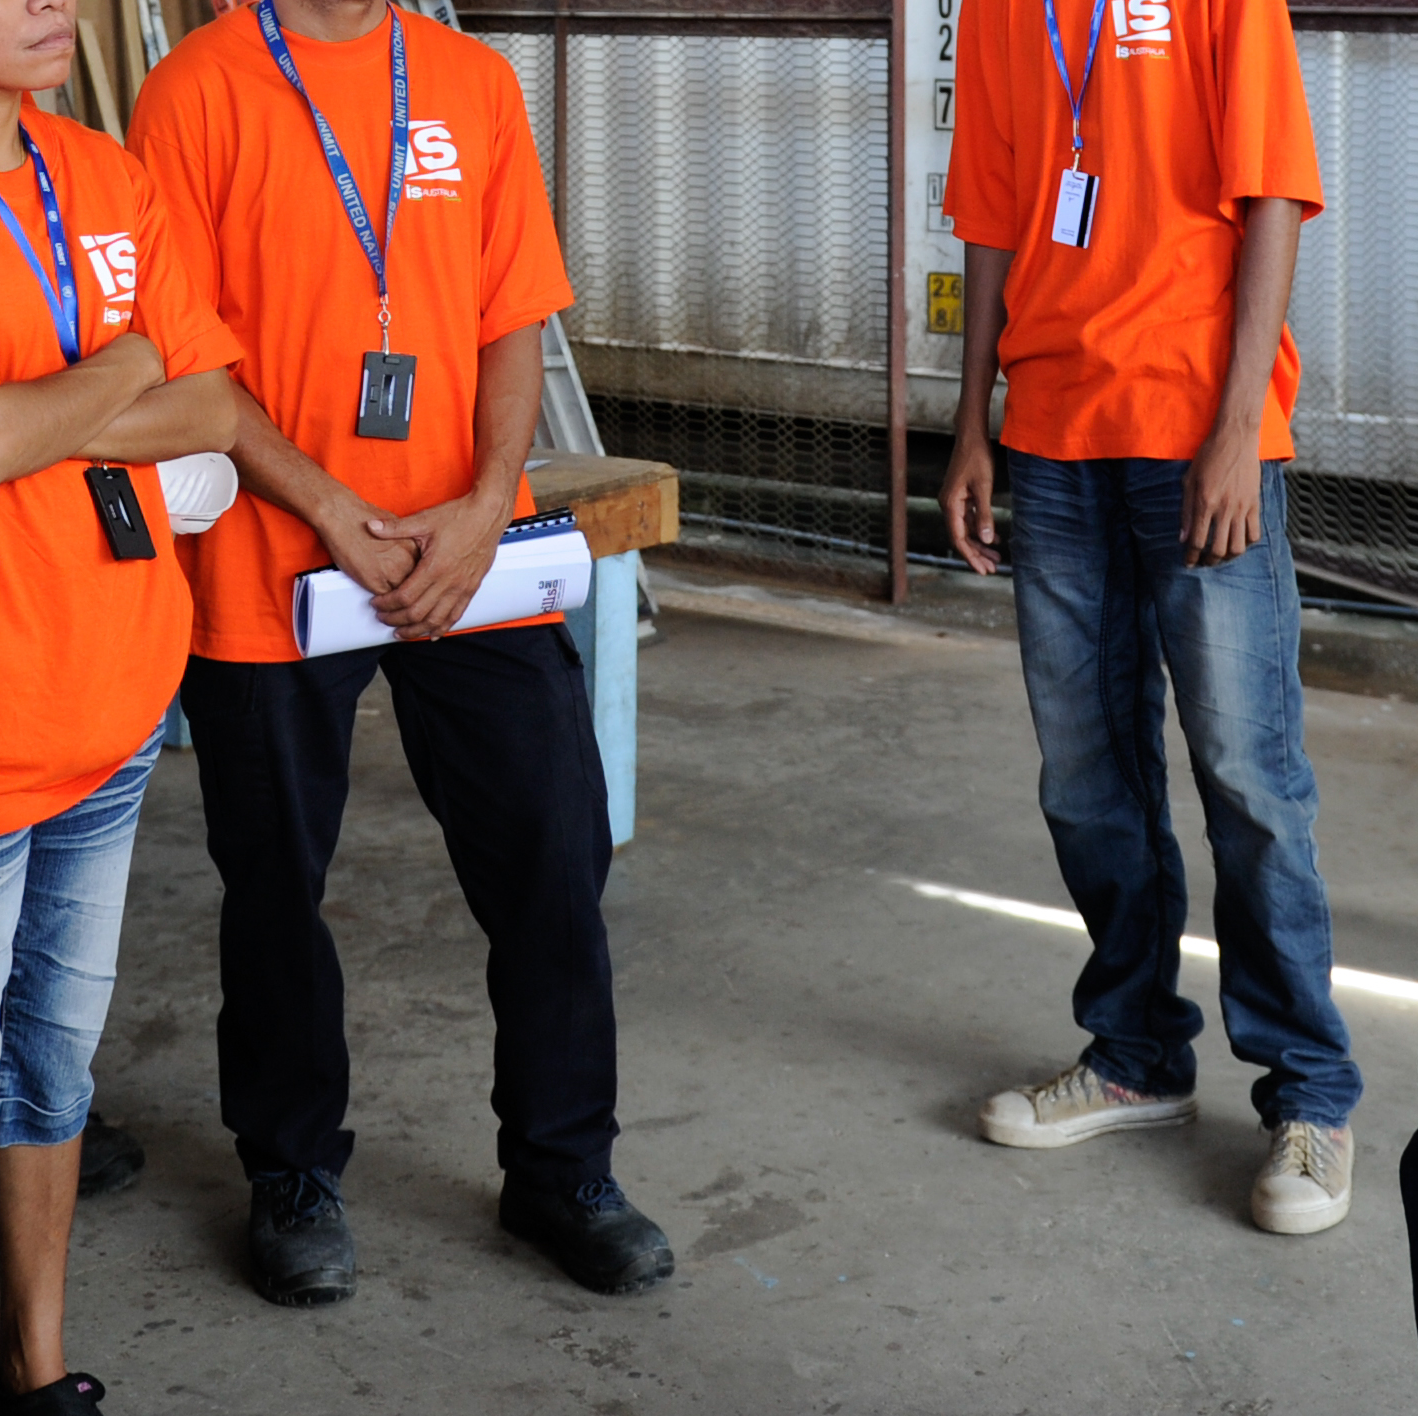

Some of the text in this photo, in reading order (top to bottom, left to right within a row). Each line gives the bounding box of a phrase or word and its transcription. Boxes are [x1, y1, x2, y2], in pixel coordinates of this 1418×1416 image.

[260, 6, 281, 44] UNMIT
[393, 20, 406, 77] NATIONS
[394, 78, 407, 129] UNITED
[391, 141, 407, 189] UNMIT
[315, 112, 383, 274] UNMIT UNITED NATIO
